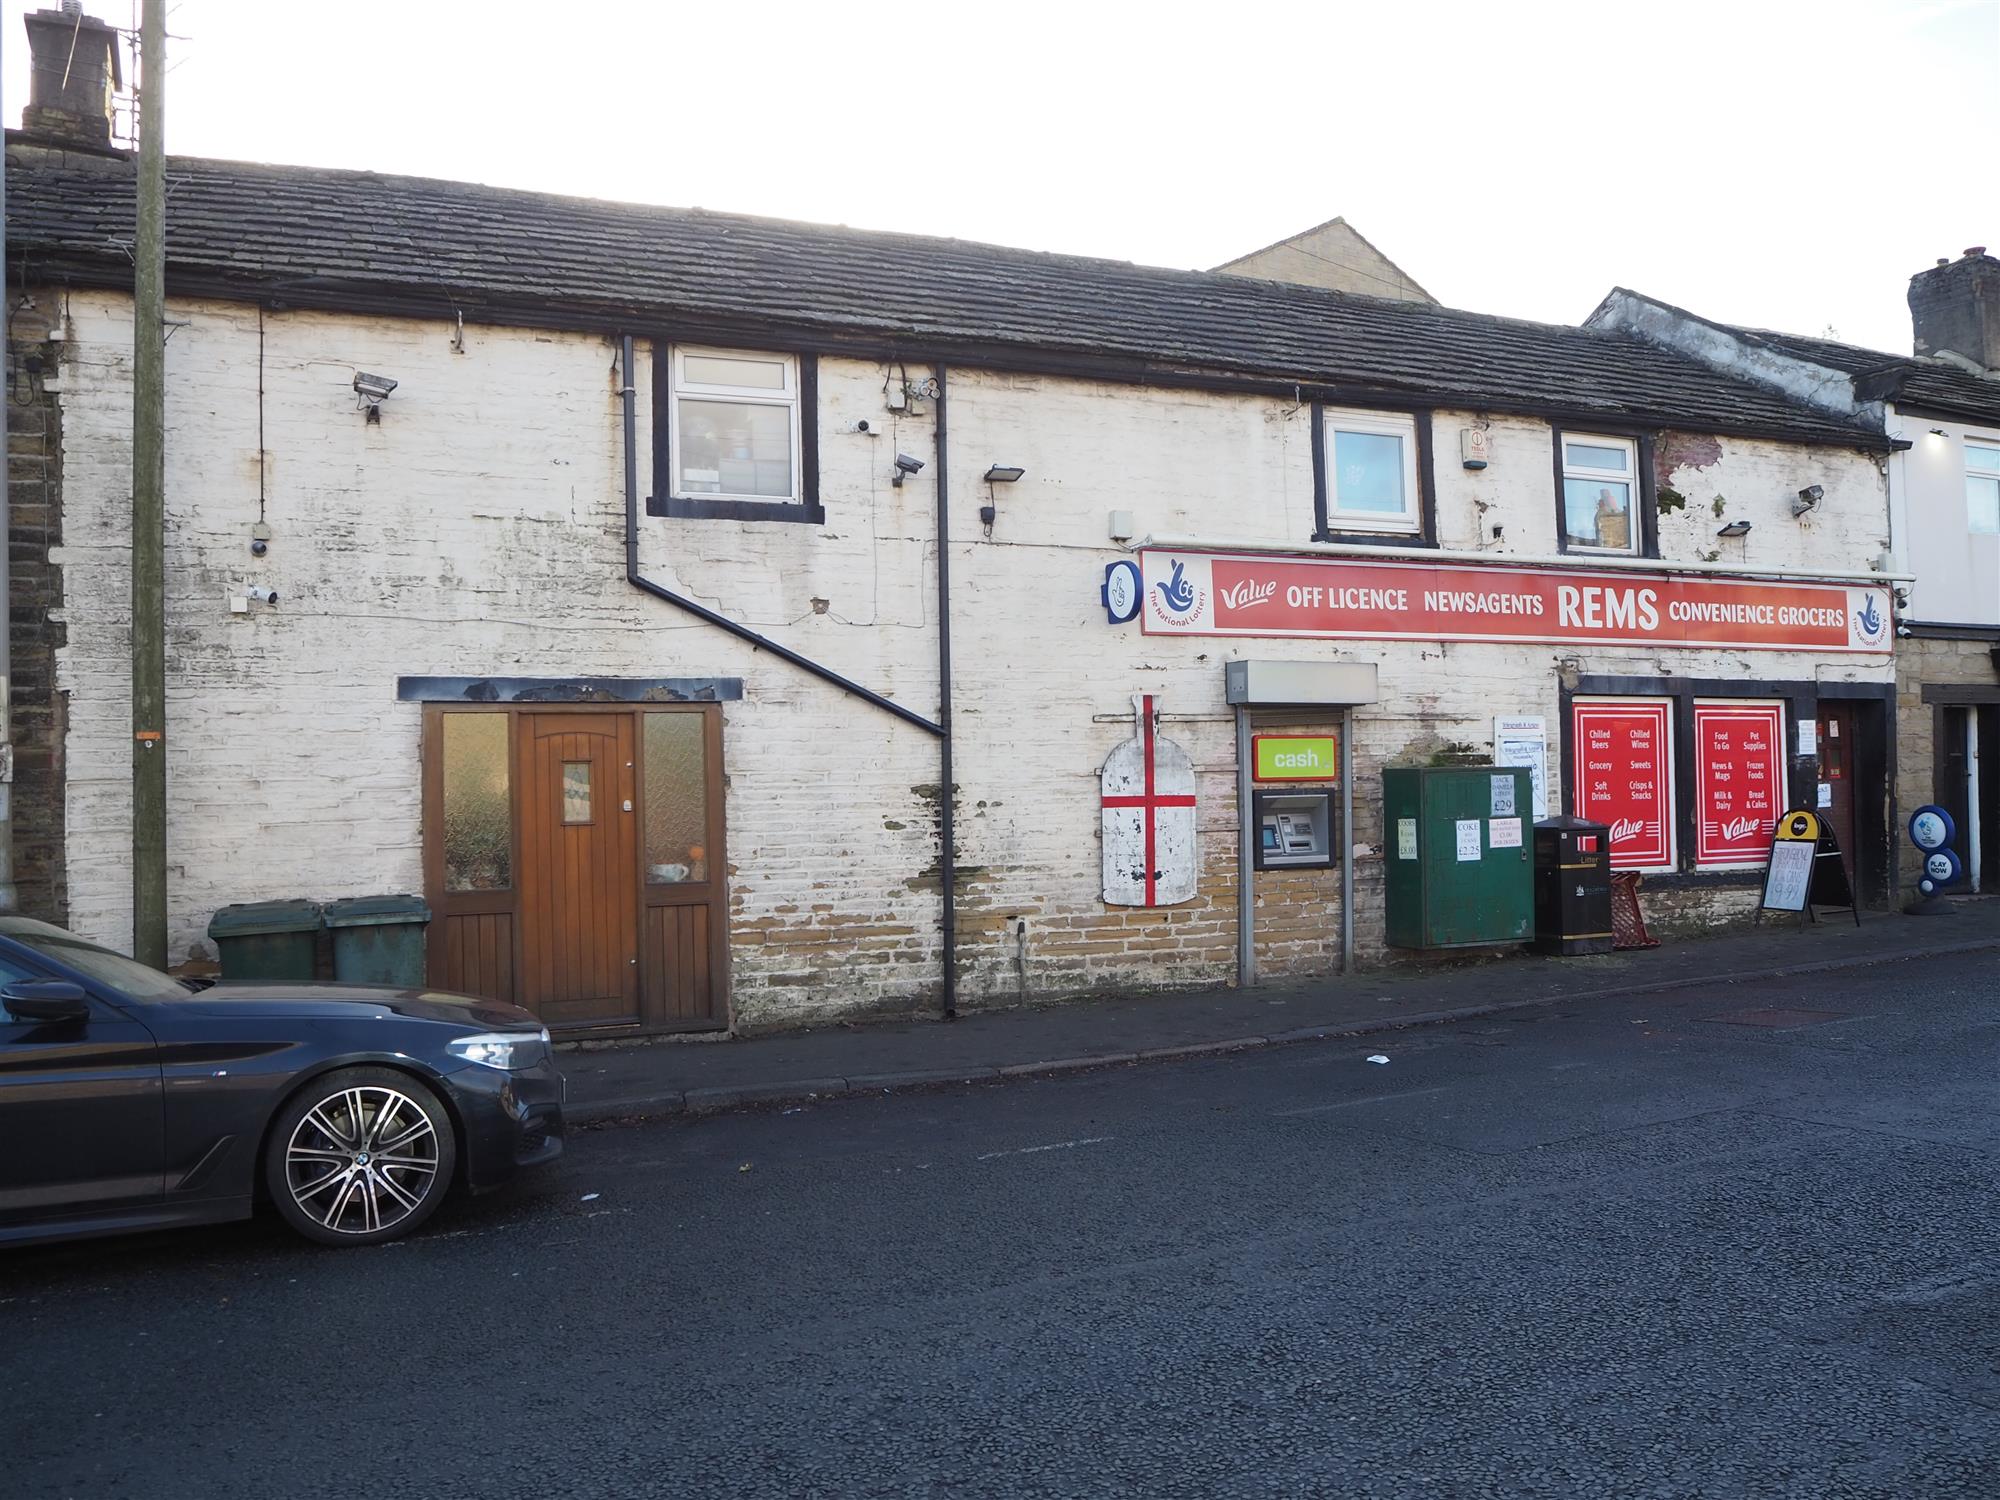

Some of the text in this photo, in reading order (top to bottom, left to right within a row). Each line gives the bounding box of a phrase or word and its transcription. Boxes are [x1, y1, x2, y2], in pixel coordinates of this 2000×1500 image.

[1150, 590, 1207, 627] The National Lottery
[1220, 578, 1844, 631] Value OFF LICENCE NEWSAGENTS REMS CONVENIENCE GROCERS
[1589, 729, 1611, 739] Chilled
[1629, 729, 1650, 739] Chilled
[1714, 732, 1729, 740] Food
[1750, 732, 1759, 740] Pet
[1591, 740, 1609, 749] Beers
[1631, 740, 1650, 749] Wines
[1713, 742, 1730, 750] To Go
[1743, 741, 1767, 751] Supplies
[1274, 748, 1319, 768] cash
[1589, 760, 1612, 771] Grocery
[1630, 760, 1651, 769] Sweets
[1711, 761, 1727, 770] News
[1746, 761, 1764, 769] Frozen
[1714, 772, 1730, 781] Mags
[1748, 771, 1764, 779] Foods
[1594, 781, 1608, 790] Soft
[1629, 781, 1653, 791] Crisps &
[1591, 792, 1611, 801] Drinks
[1631, 791, 1652, 800] Snacks
[1713, 791, 1732, 799] Milk &
[1748, 791, 1764, 799] Bread
[1494, 800, 1512, 811] £29
[1716, 801, 1731, 811] Dairy
[1745, 800, 1768, 809] & Cakes
[1457, 823, 1479, 831] COKE
[1721, 816, 1760, 841] Value
[1458, 846, 1480, 855] £2.25
[1930, 860, 1947, 868] PLAY
